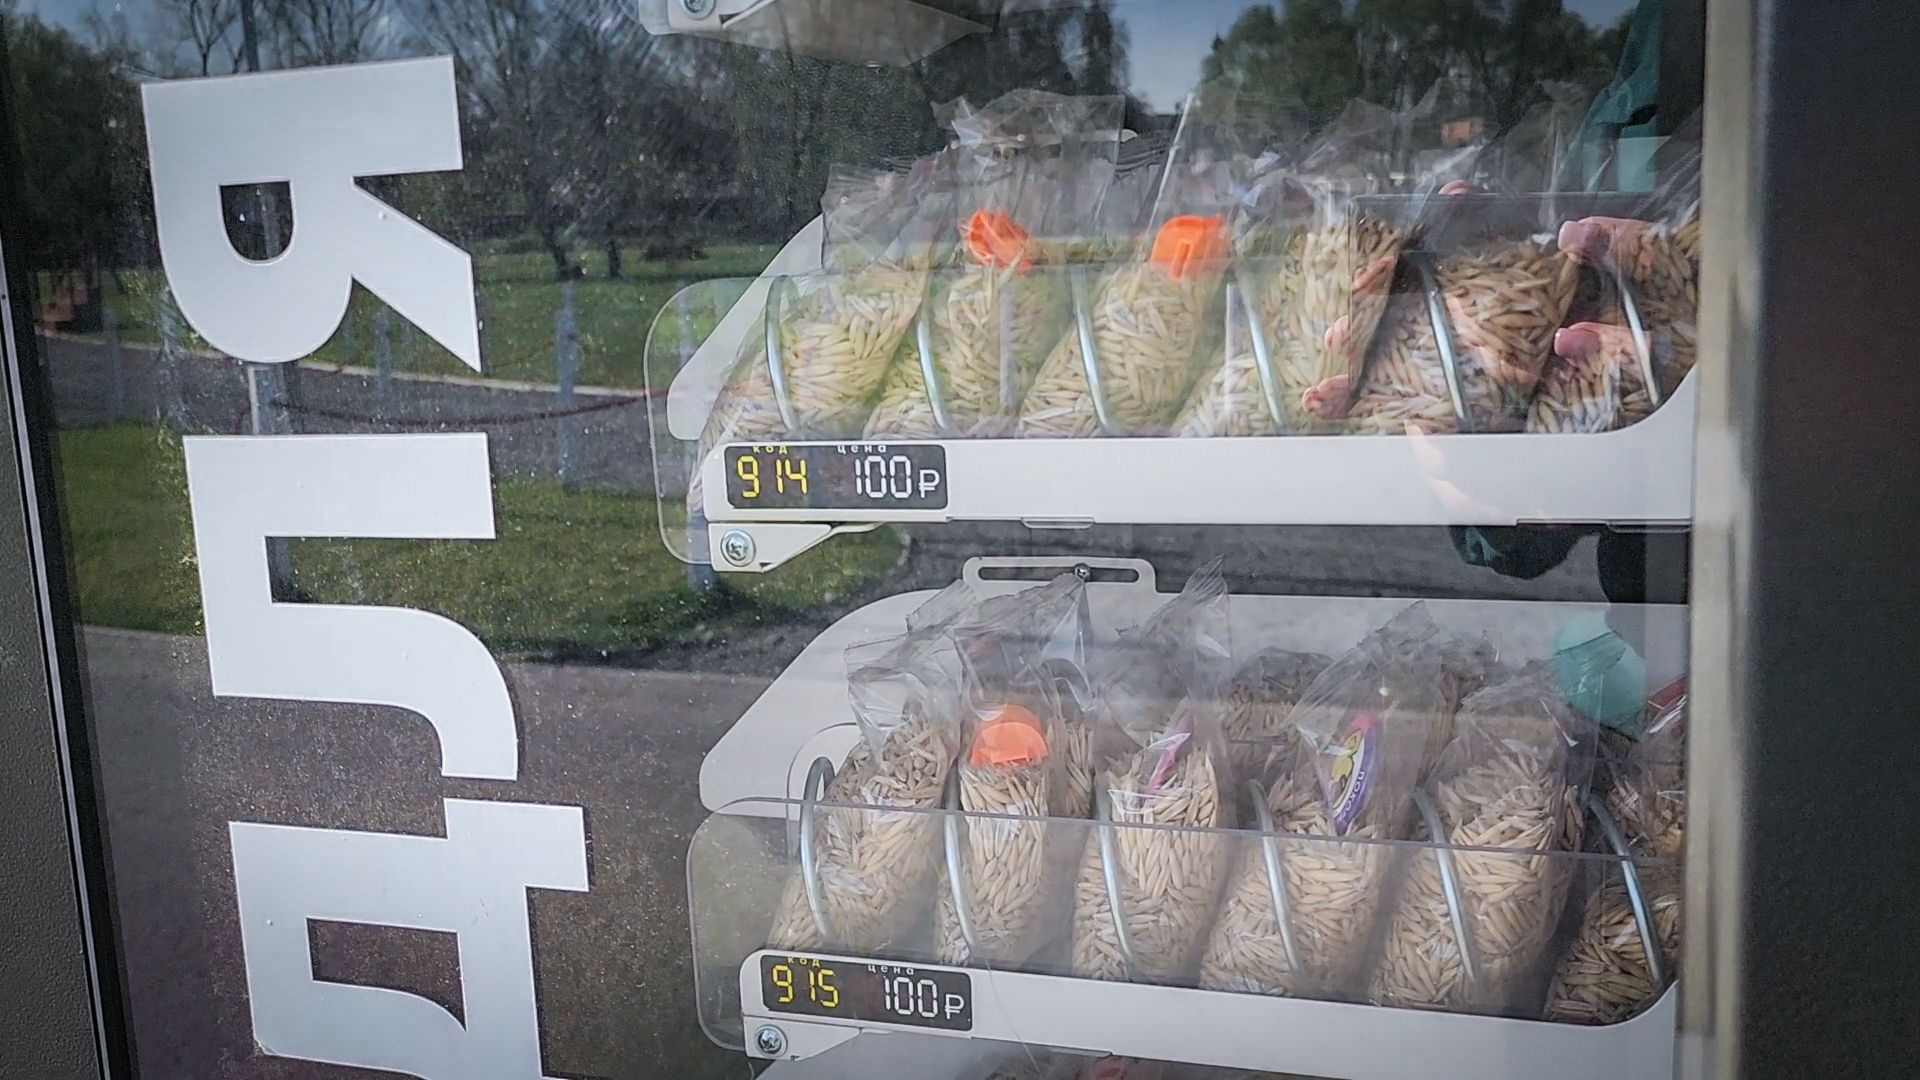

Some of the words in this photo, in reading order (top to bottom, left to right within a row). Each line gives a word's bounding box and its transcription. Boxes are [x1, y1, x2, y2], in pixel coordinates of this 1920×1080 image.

[753, 445, 788, 455] код
[837, 445, 887, 455] цена
[736, 455, 809, 498] 914
[141, 55, 589, 1080] ДЛЯ
[772, 964, 840, 1009] 915
[787, 955, 822, 968] код
[867, 964, 915, 976] цена
